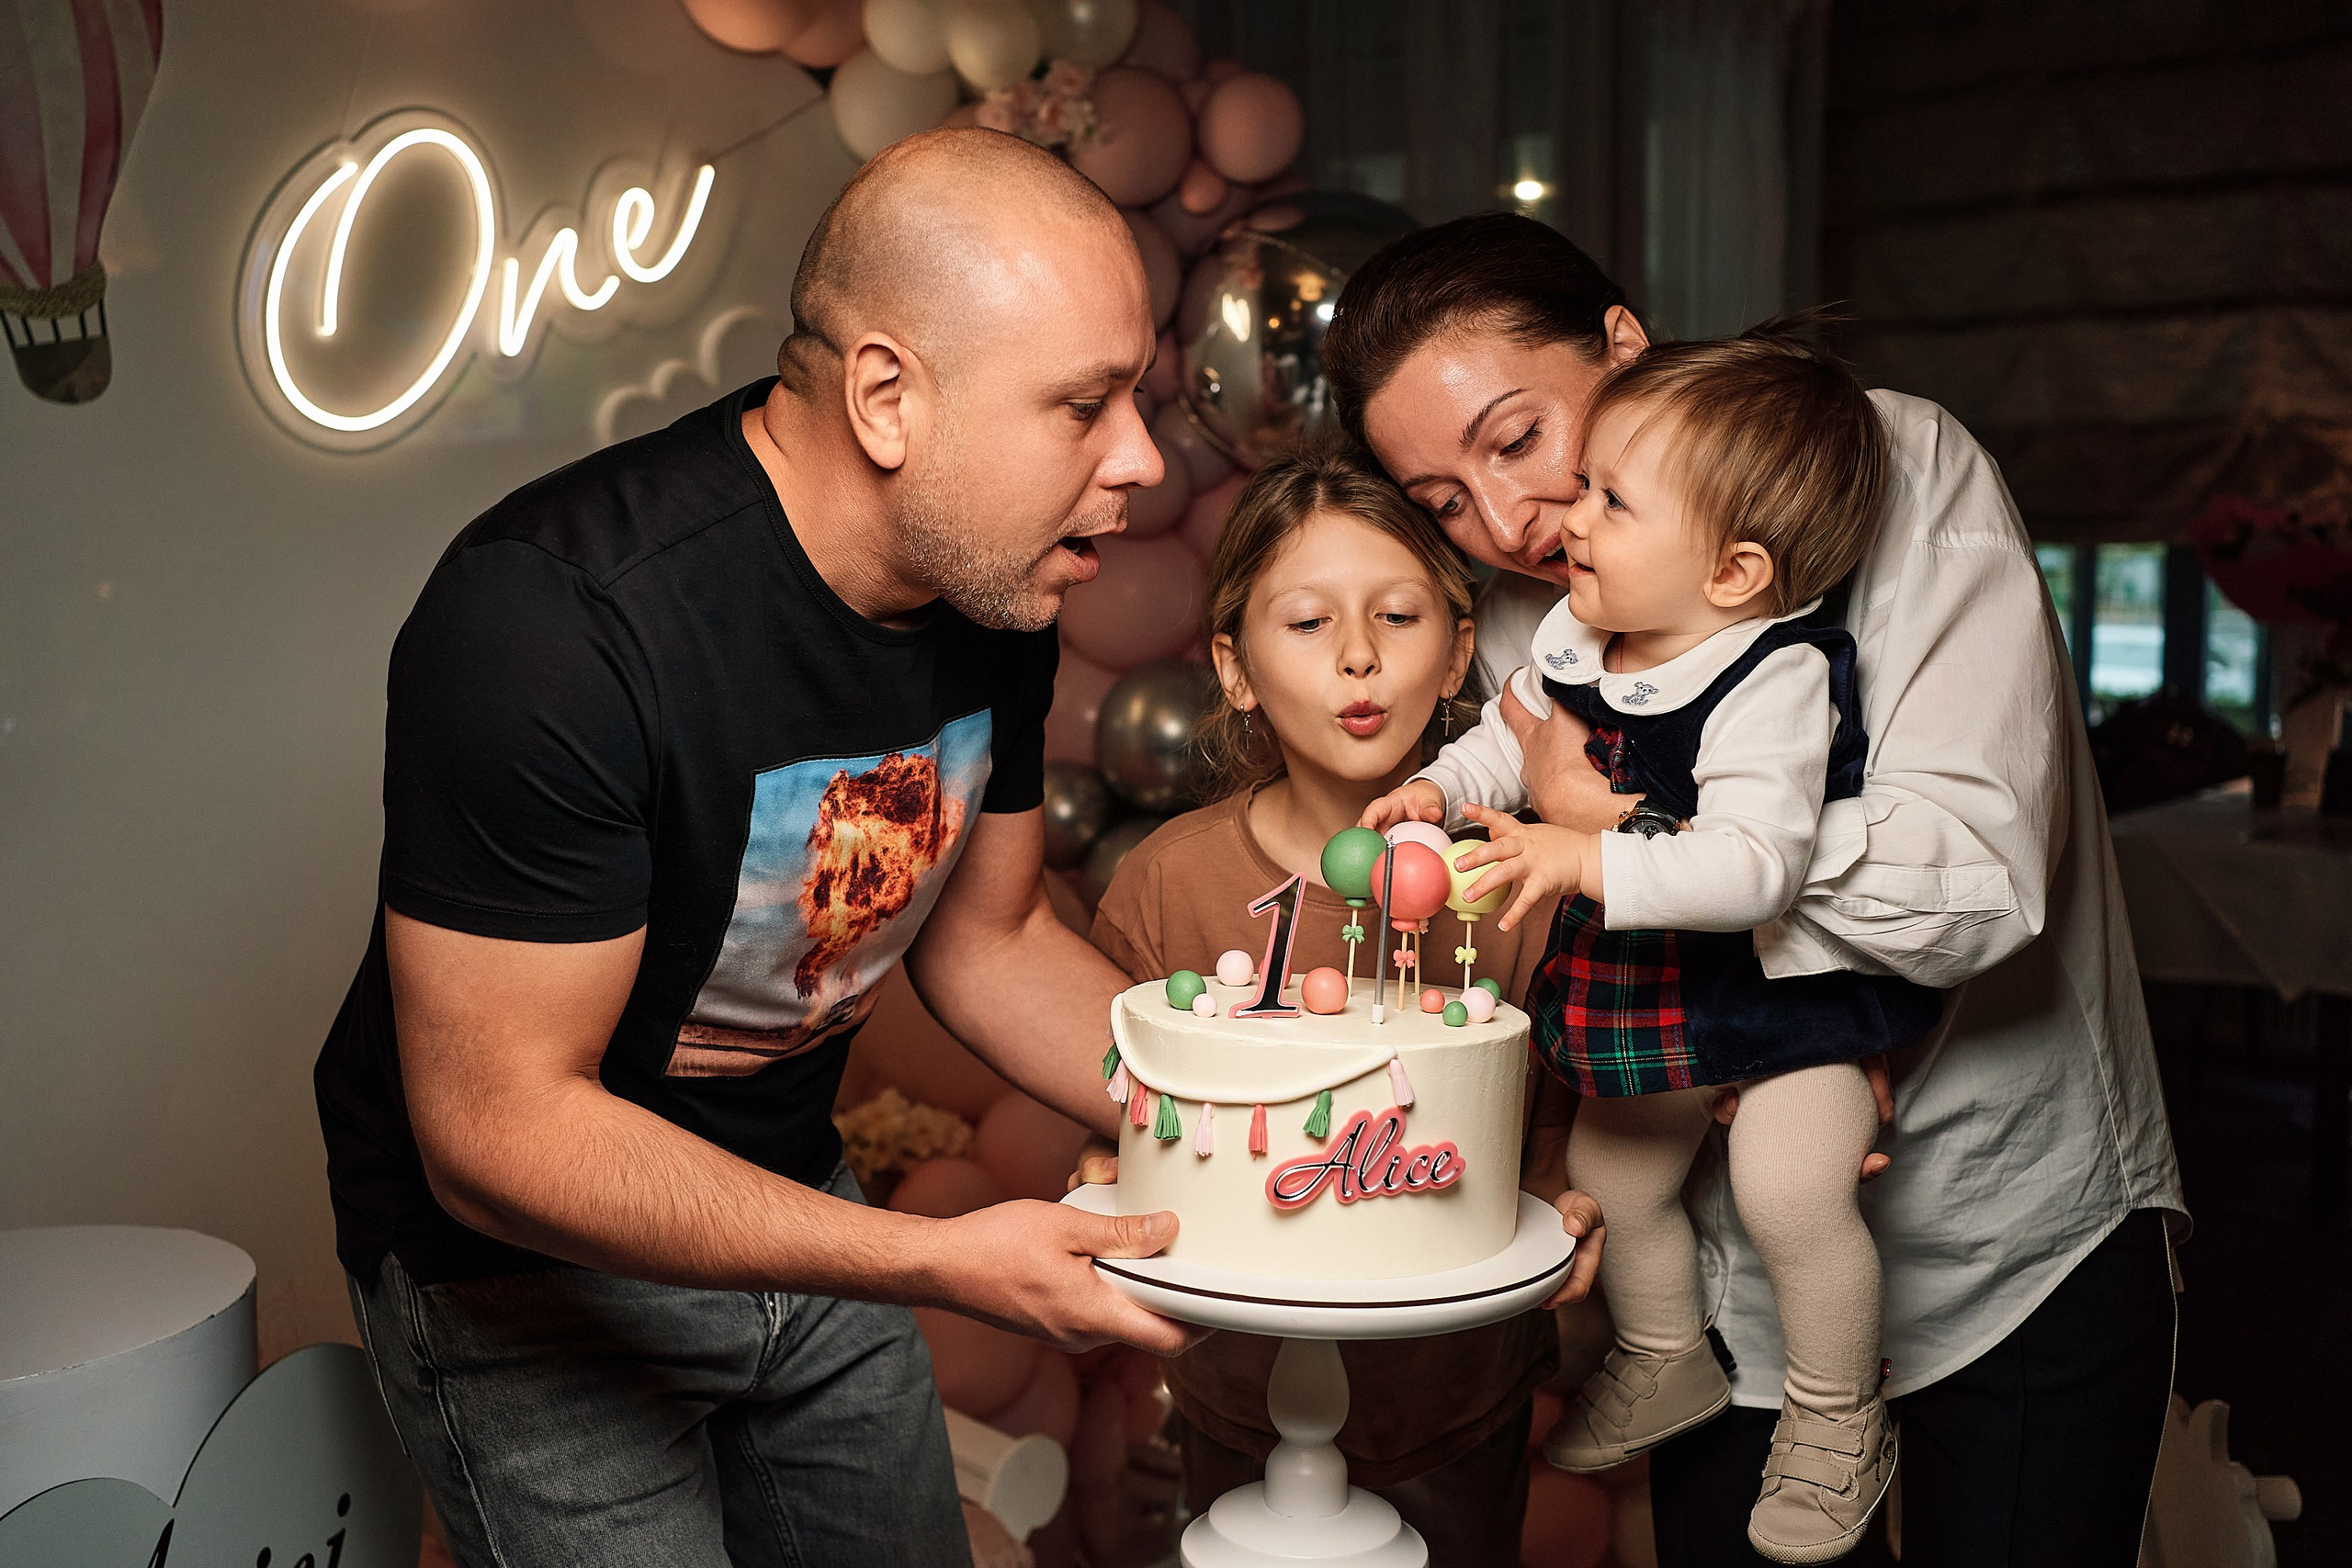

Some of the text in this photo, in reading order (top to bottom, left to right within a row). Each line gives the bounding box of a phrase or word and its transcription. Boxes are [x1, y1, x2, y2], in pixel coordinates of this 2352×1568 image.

[266, 127, 715, 432] One
[1234, 874, 1304, 1017] 1
[1272, 1116, 1461, 1203] Alice
